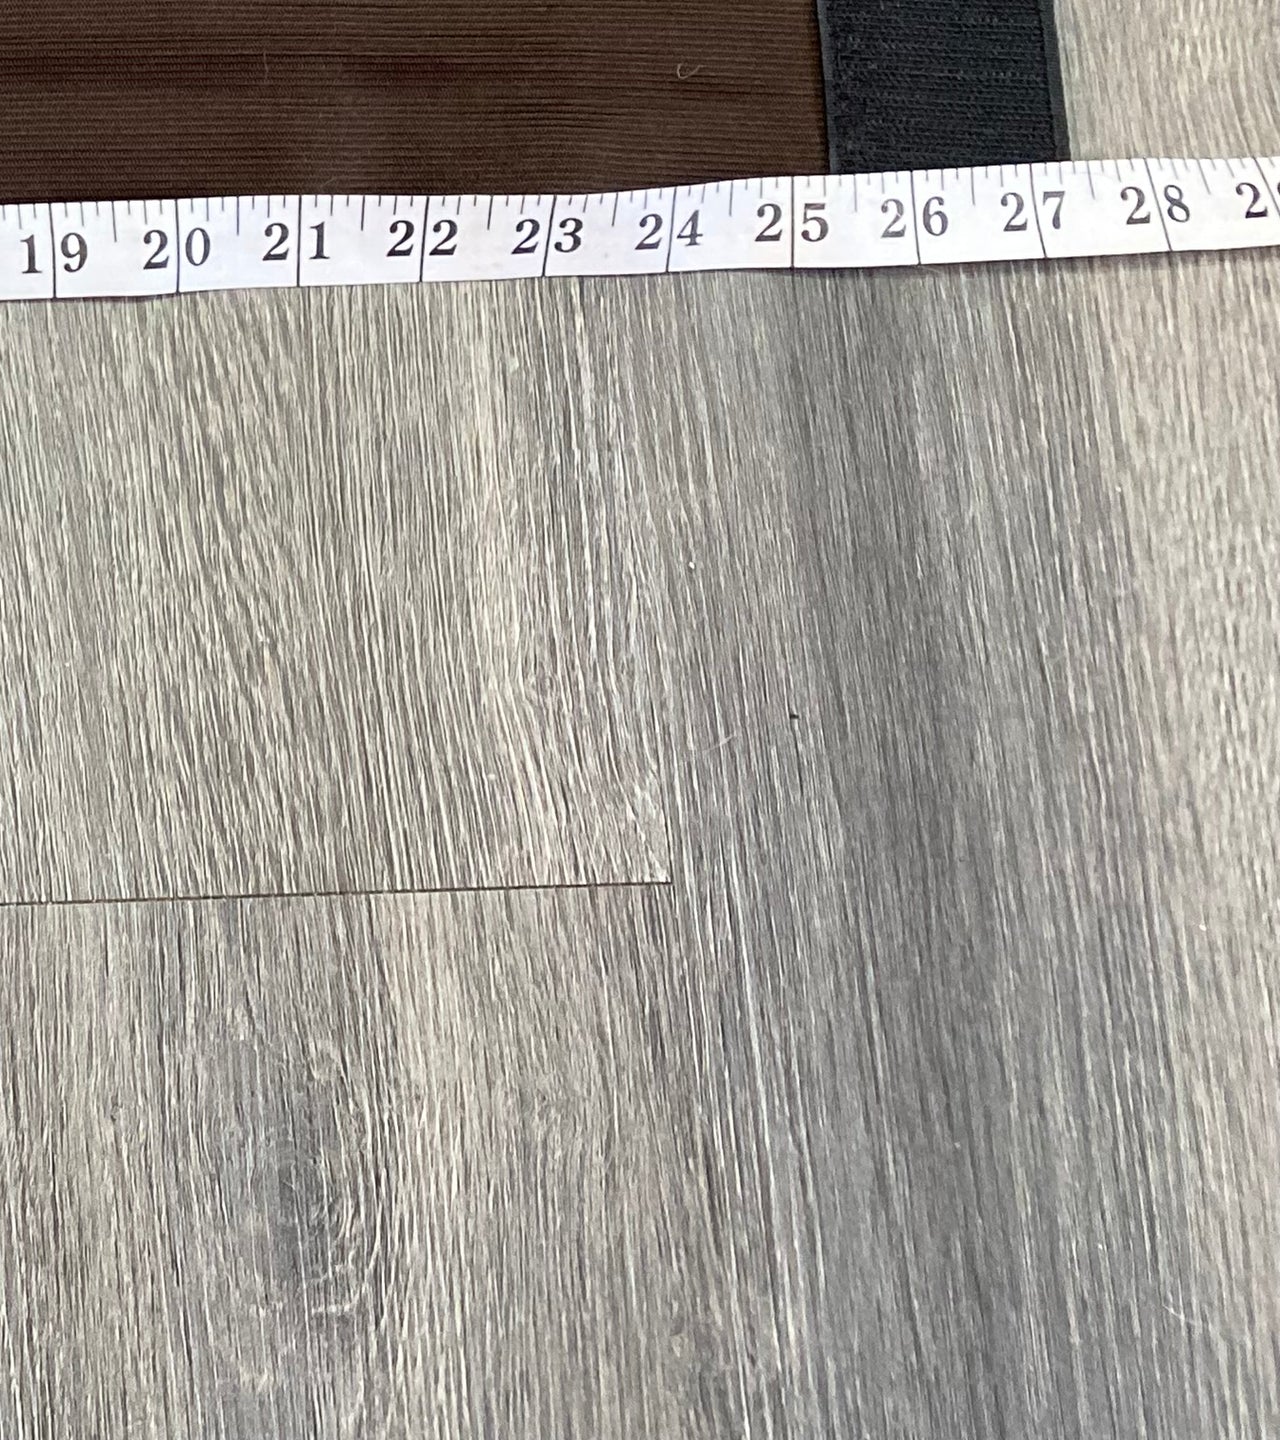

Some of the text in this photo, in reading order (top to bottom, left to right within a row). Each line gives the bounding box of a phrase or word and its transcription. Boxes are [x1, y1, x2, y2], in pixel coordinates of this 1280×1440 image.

[20, 232, 88, 274] 19
[143, 227, 212, 270] 20
[262, 221, 330, 261] 21
[386, 219, 458, 257] 22
[511, 217, 583, 255] 23
[634, 209, 704, 251] 24
[755, 202, 829, 243] 25
[881, 196, 949, 238] 26
[1001, 190, 1066, 232] 27
[1120, 185, 1190, 225] 28
[1236, 181, 1280, 218] 2
